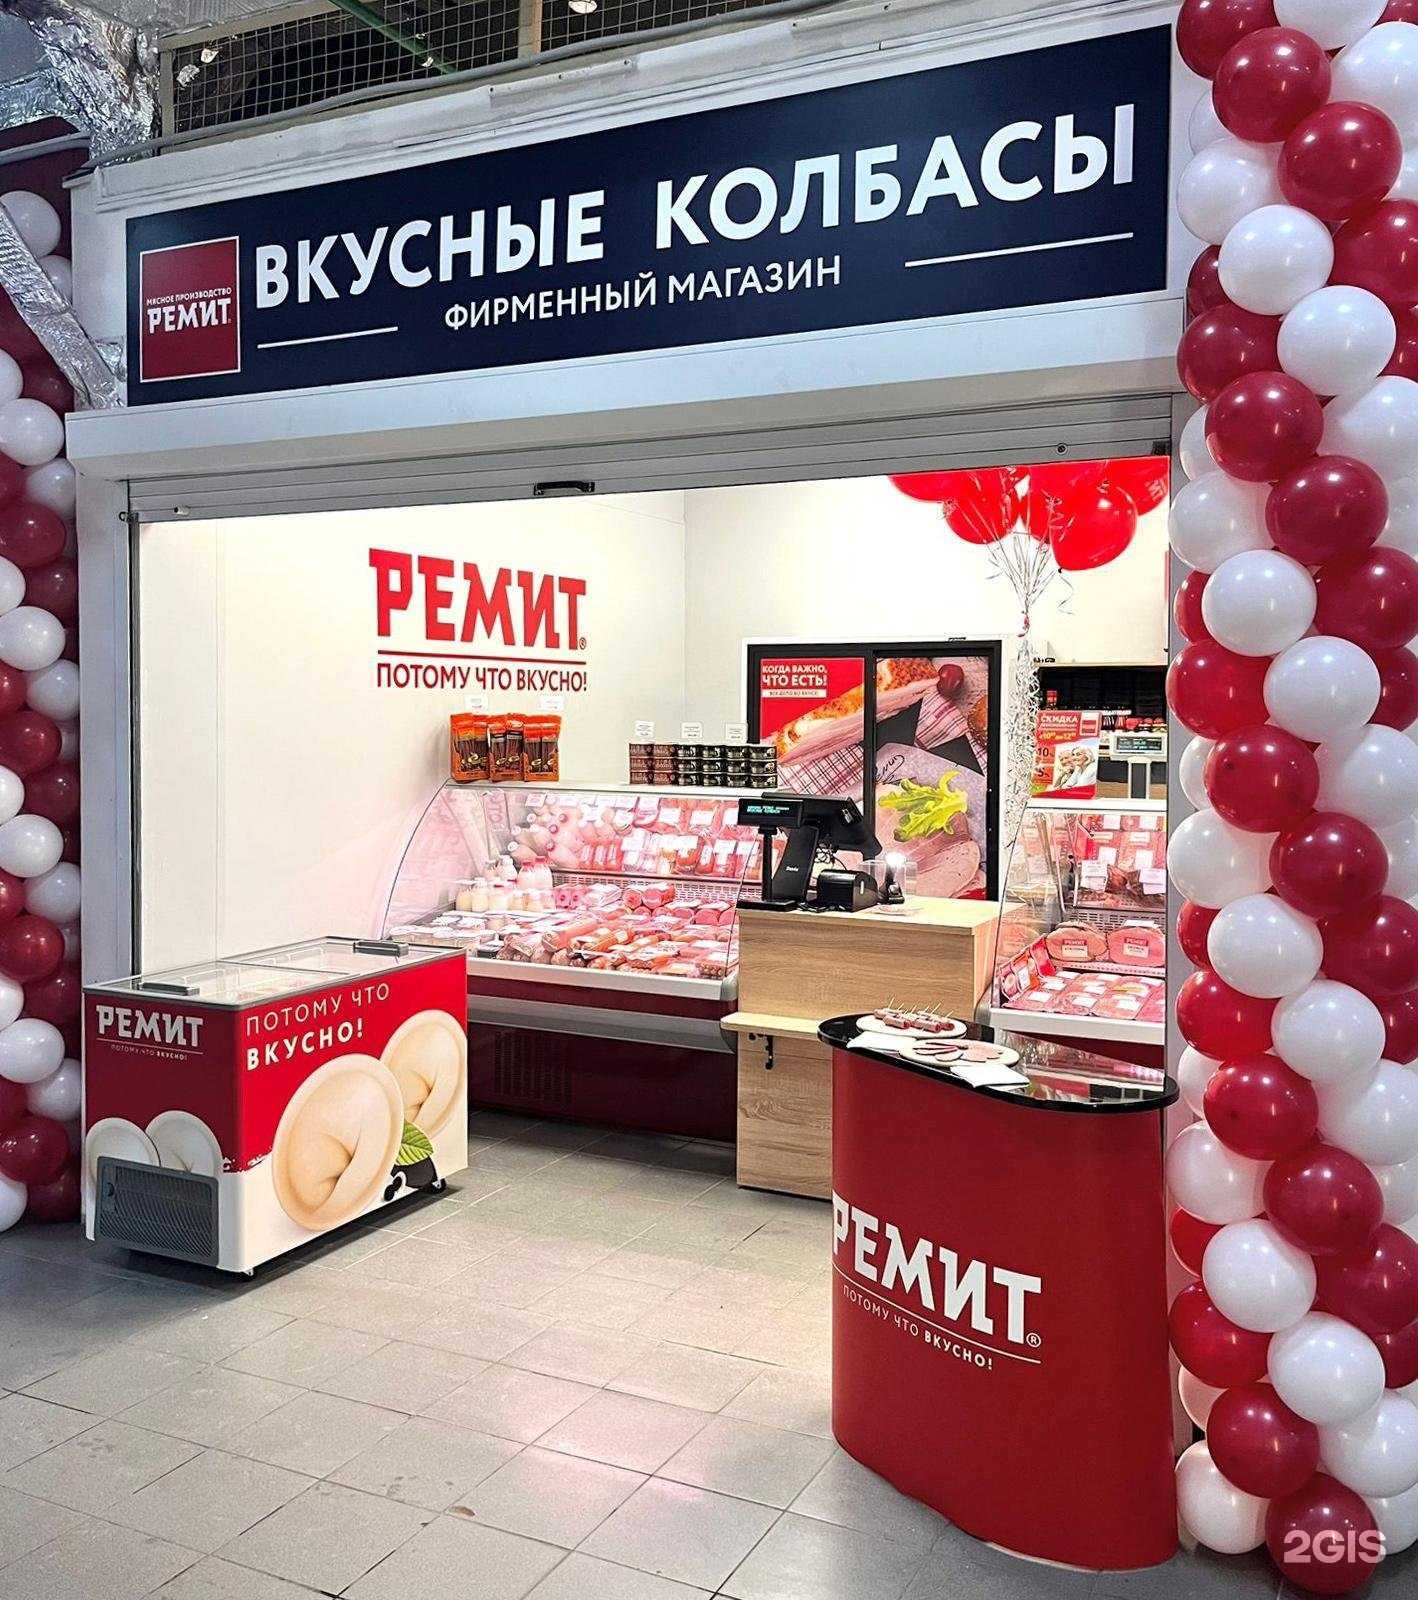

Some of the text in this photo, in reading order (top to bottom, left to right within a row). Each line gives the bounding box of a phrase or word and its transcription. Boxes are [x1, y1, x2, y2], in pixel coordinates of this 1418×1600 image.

[255, 103, 1135, 309] ВКУСНЫЕ КОЛБАСЫ
[146, 287, 232, 307] МЯСНОЕ ПРОИЗВОДСТВО
[444, 255, 841, 331] ФИРМЕННЫЙ МАГАЗИН
[146, 297, 232, 334] РЕМИТ
[376, 662, 587, 692] ПОТОМУ ЧТО ВКУСНО!
[762, 665, 791, 674] КОГДА
[762, 674, 828, 687] ЧТО ЕСТЬ!
[96, 1005, 204, 1047] РЕМИТ
[246, 983, 390, 1036] ПОТОМУ ЧТО
[246, 1018, 363, 1071] ВКУСНО!
[842, 1284, 993, 1371] ПОТОМУ ЧТО ВКУСНО!
